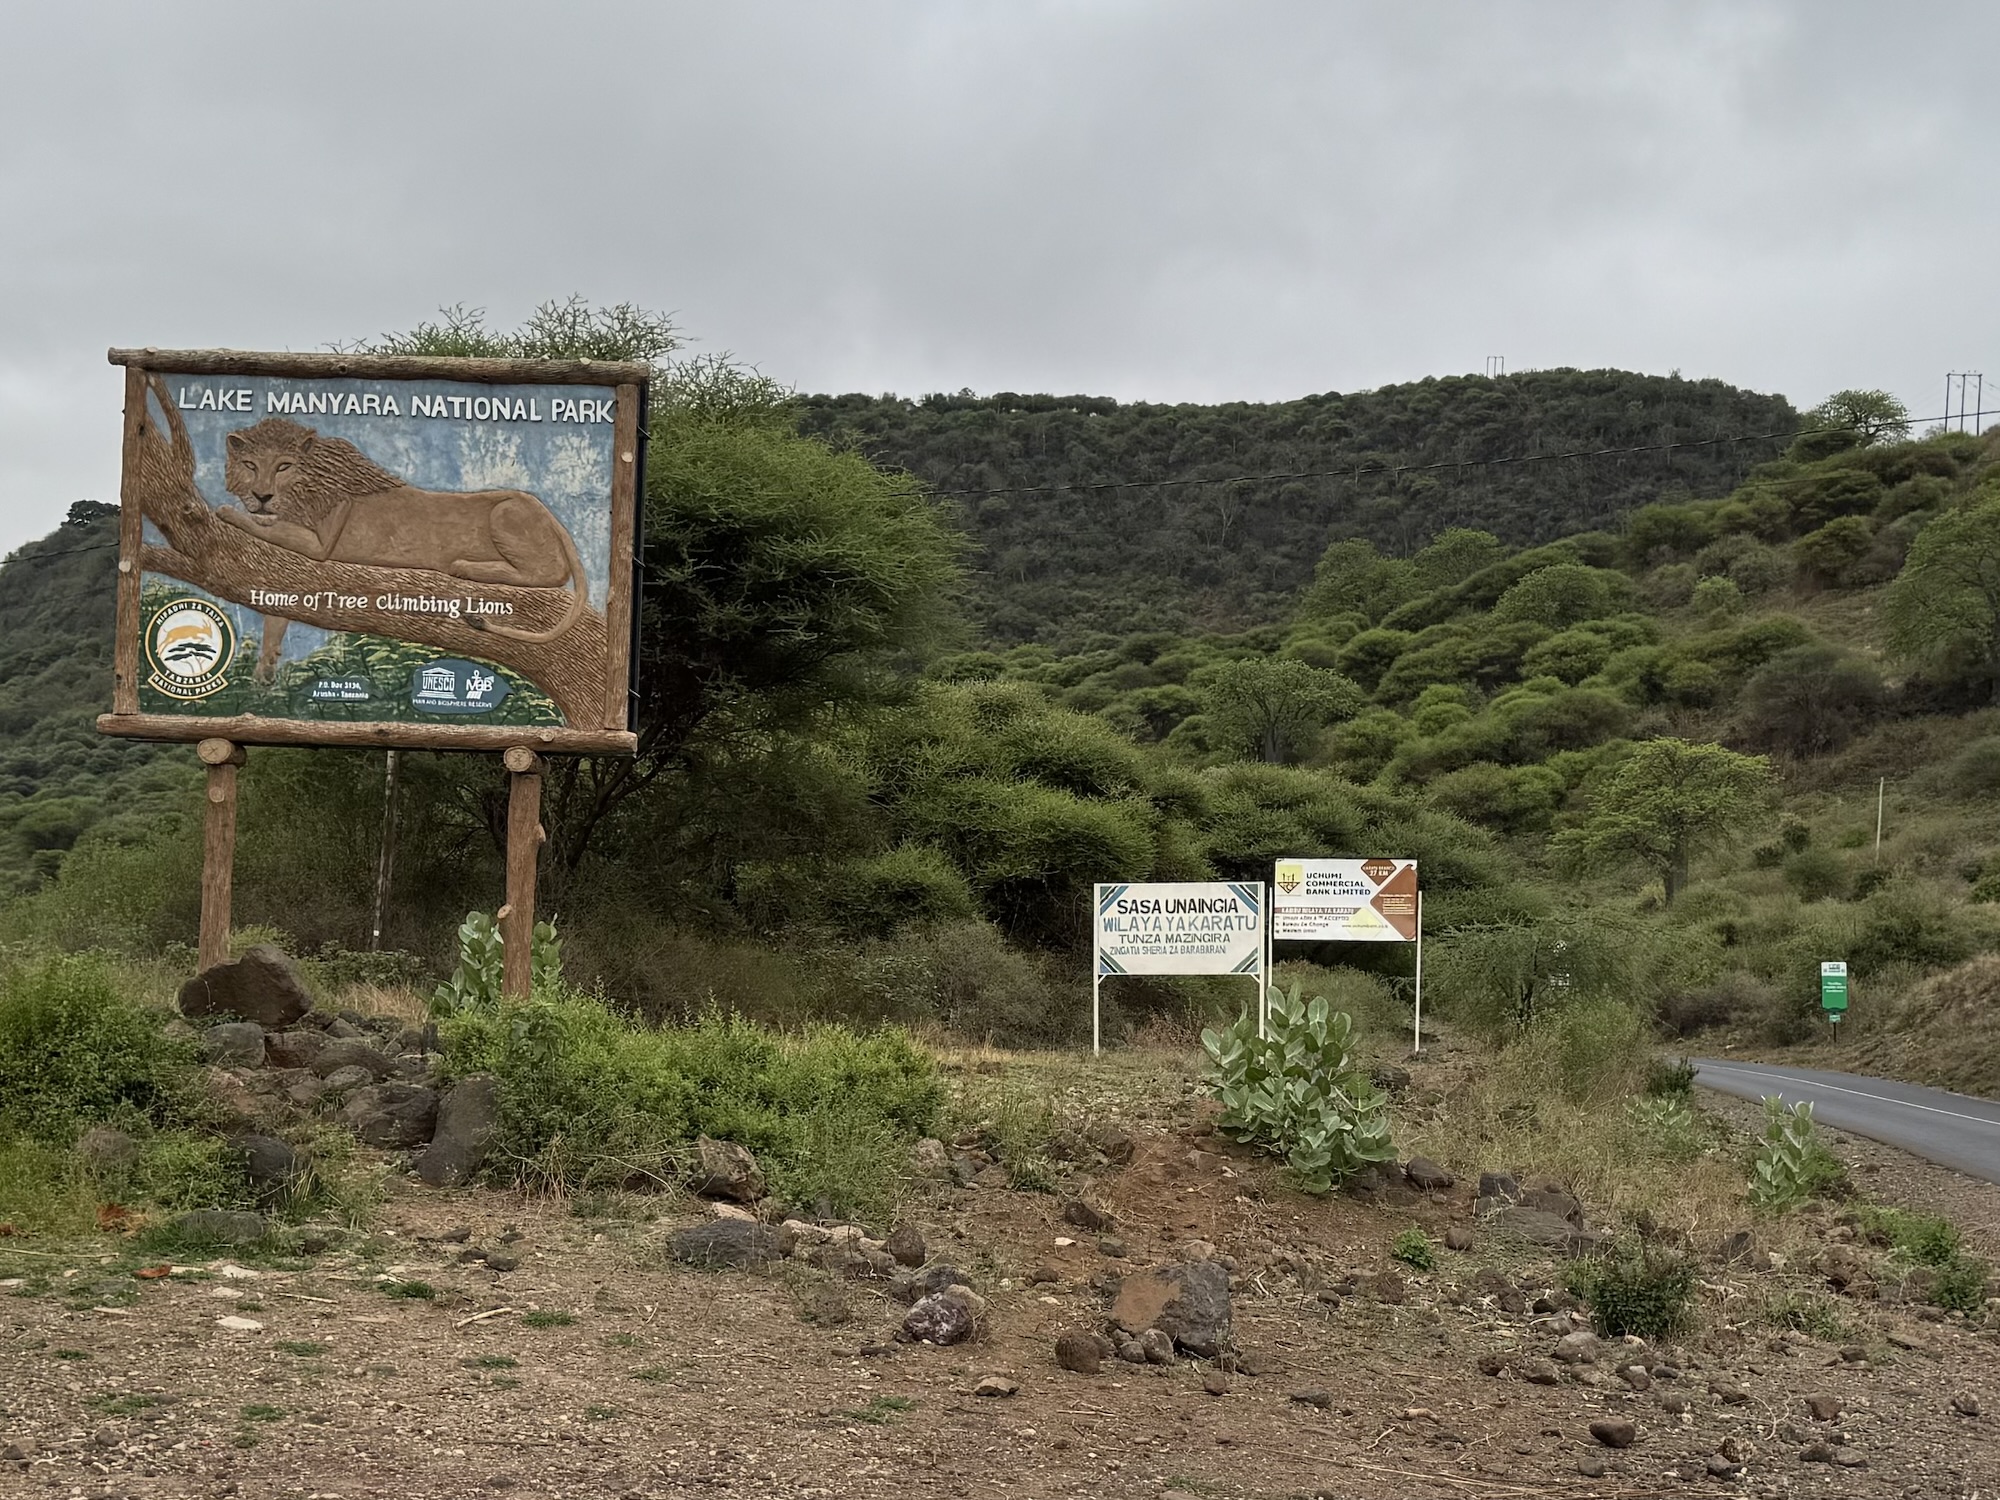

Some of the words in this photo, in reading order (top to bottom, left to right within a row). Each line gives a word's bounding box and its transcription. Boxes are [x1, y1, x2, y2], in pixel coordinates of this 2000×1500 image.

[178, 387, 253, 411] LAKE
[267, 391, 400, 416] MANYARA
[411, 395, 542, 421] NATIONAL
[551, 399, 614, 423] PARK
[250, 590, 298, 606] Home
[303, 592, 322, 611] of
[324, 592, 368, 608] Tree
[466, 596, 513, 615] Lions
[156, 603, 188, 625] HIFADHI
[192, 603, 202, 611] ZA
[164, 669, 213, 685] TANZANIA
[422, 676, 455, 691] UNESCO
[153, 675, 192, 696] NATIONAL
[195, 678, 224, 695] PARKS
[312, 690, 336, 698] Arusha
[341, 690, 369, 699] Tanzania
[1306, 880, 1365, 888] COMMERCIAL
[1306, 888, 1331, 896] BANK
[1332, 888, 1372, 896] LIMITED
[1117, 899, 1162, 915] SASA
[1165, 898, 1239, 915] UNAINGIA
[1103, 916, 1162, 932] WILAYA
[1188, 915, 1257, 932] KARATU
[1119, 933, 1162, 945] TUNZA
[1142, 945, 1168, 955] SHERIA
[1169, 945, 1179, 955] ZA
